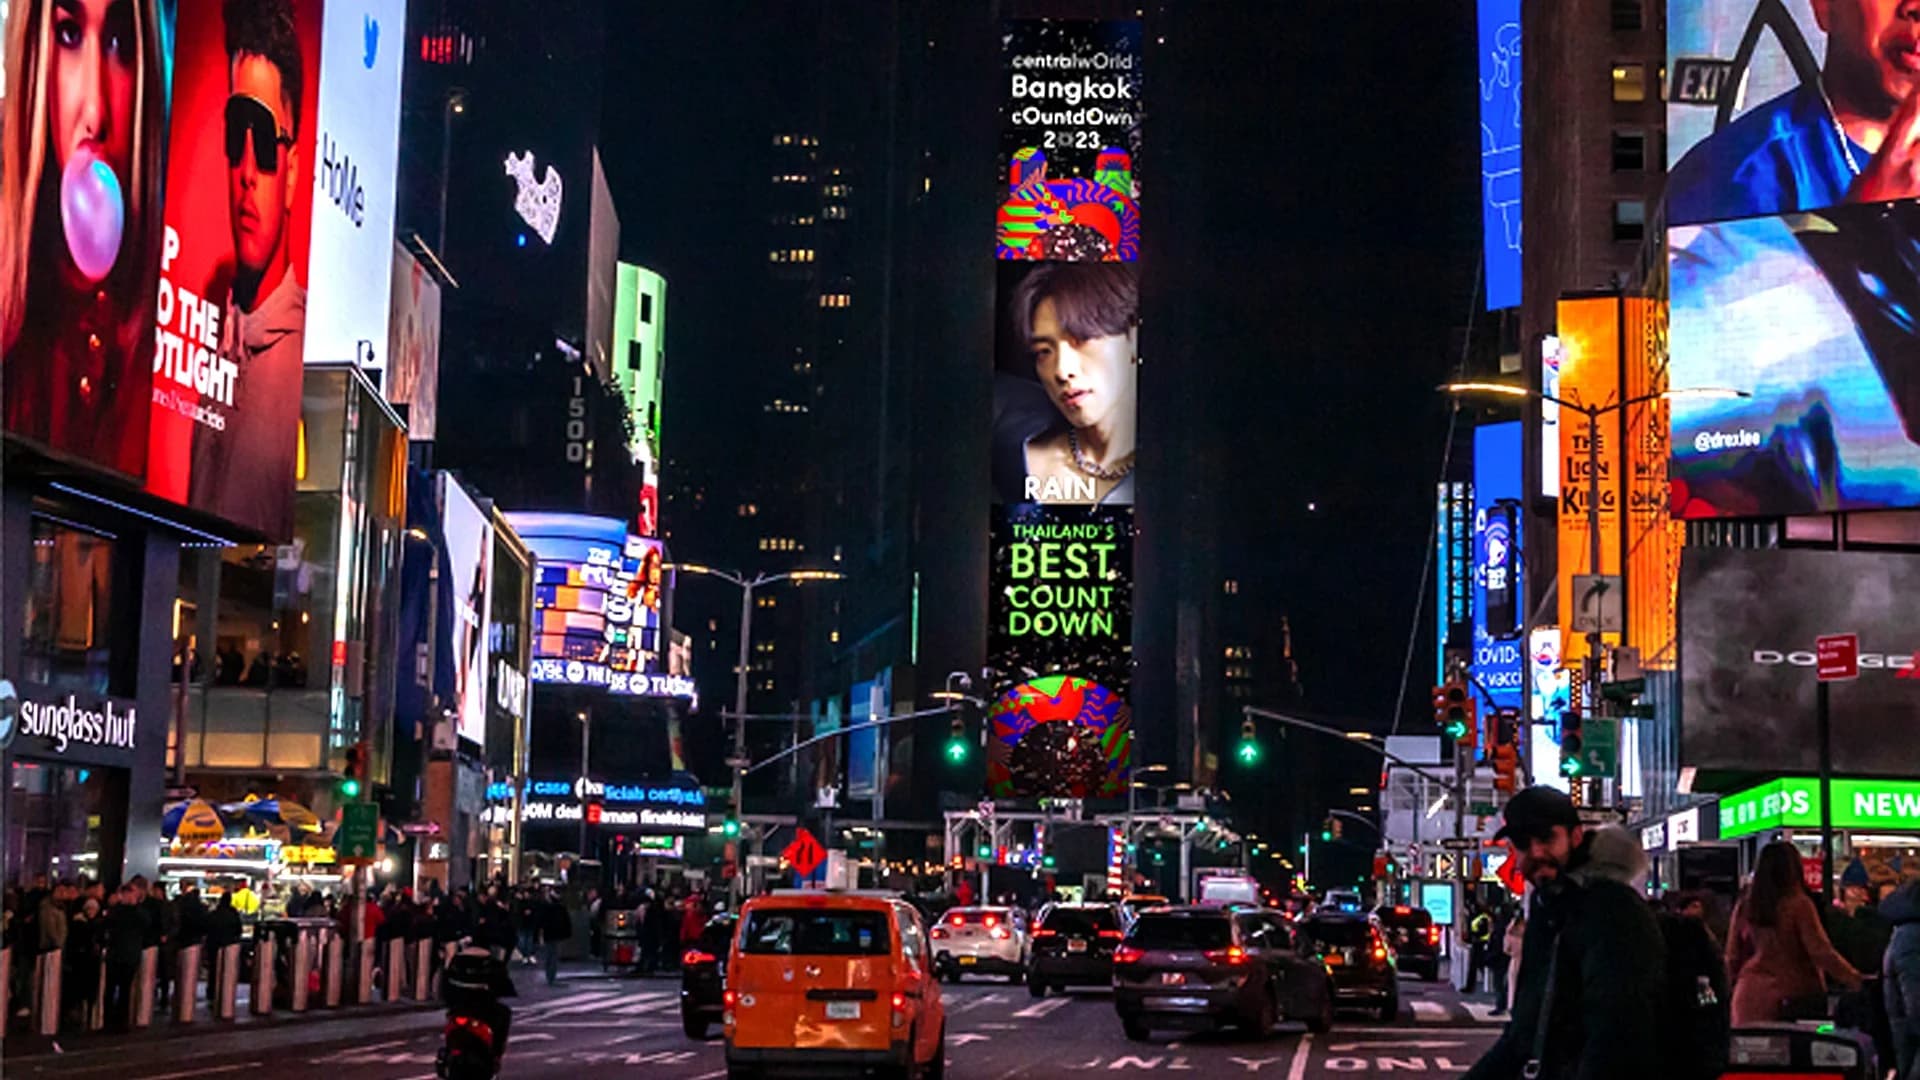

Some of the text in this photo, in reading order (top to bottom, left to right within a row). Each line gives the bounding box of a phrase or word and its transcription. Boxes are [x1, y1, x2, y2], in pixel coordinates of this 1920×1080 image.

[1012, 75, 1131, 105] Bangkok
[178, 286, 220, 350] THE
[566, 376, 585, 462] 1500
[1024, 477, 1096, 500] RAIN
[1562, 487, 1615, 514] KIG
[1011, 543, 1116, 579] BEST
[1010, 586, 1113, 608] COUNT
[1009, 611, 1113, 636] DOWN
[1476, 646, 1521, 665] OVID-
[1753, 650, 1915, 668] DOGE
[20, 694, 136, 753] sunglass hut
